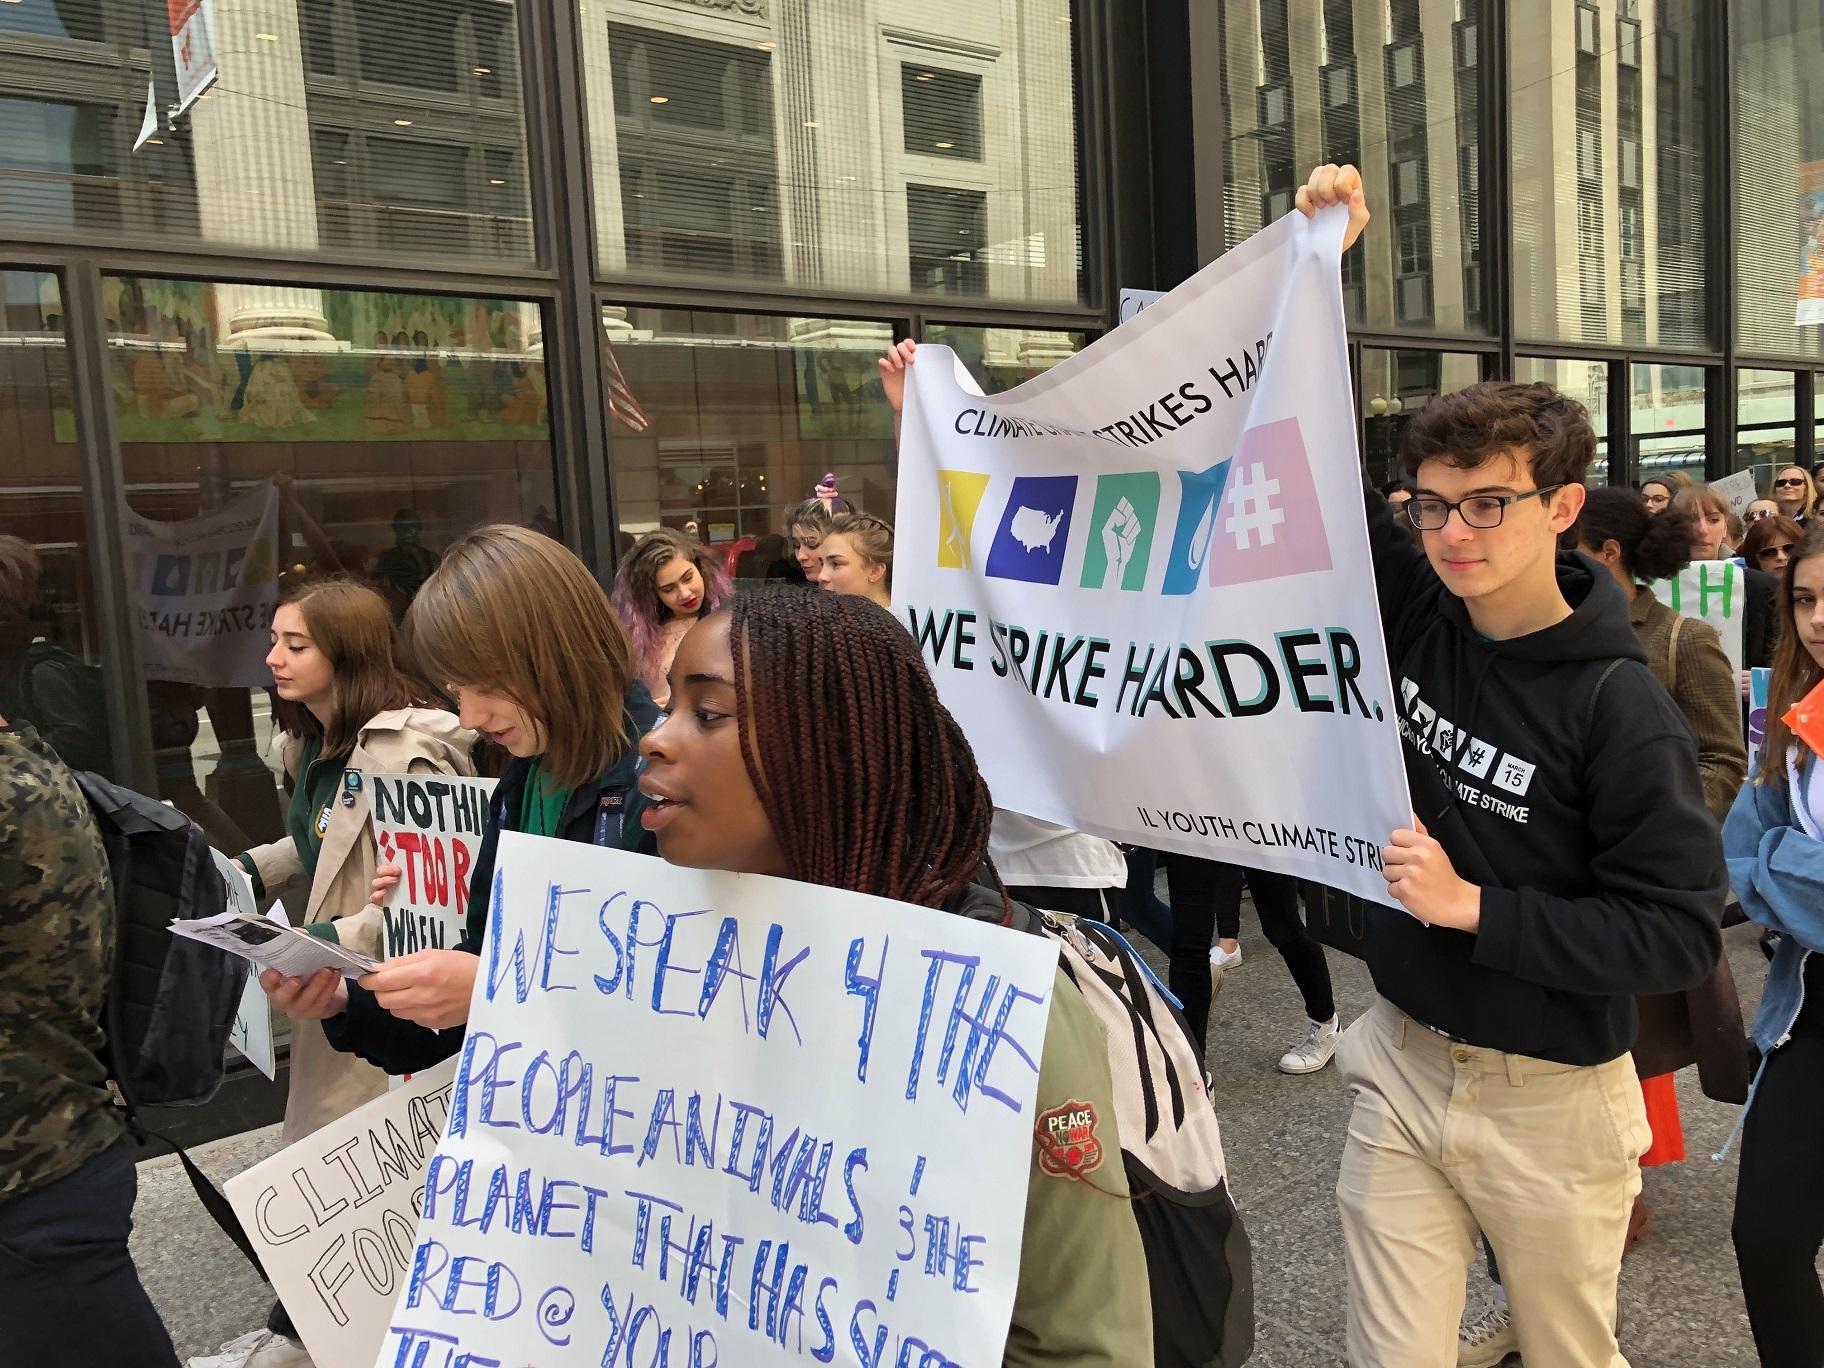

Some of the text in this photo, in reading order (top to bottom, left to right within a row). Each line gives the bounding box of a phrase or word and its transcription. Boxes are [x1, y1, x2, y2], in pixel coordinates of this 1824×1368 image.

[955, 409, 1043, 439] CLIMATE
[907, 604, 977, 671] WE
[1115, 627, 1385, 723] HARDER.
[1503, 769, 1524, 787] 15
[1507, 762, 1526, 774] MARCH
[1136, 807, 1158, 829] IL
[1156, 809, 1239, 840] YOUTH
[1243, 821, 1341, 858] CLIMATE
[1480, 795, 1530, 824] STRIKE
[394, 831, 449, 908] TOO
[486, 867, 1046, 1115] WE SPEAK 4 THE
[1047, 1109, 1093, 1132] PEACE
[1054, 1125, 1090, 1145] NO WAR
[449, 1031, 641, 1156] PEOPLE
[637, 1087, 868, 1244] ANIMALS
[923, 1213, 987, 1293] THE
[407, 1238, 522, 1321] RED
[423, 1154, 608, 1254] PLANET
[624, 1189, 746, 1321] THAT
[749, 1238, 839, 1364] HAS
